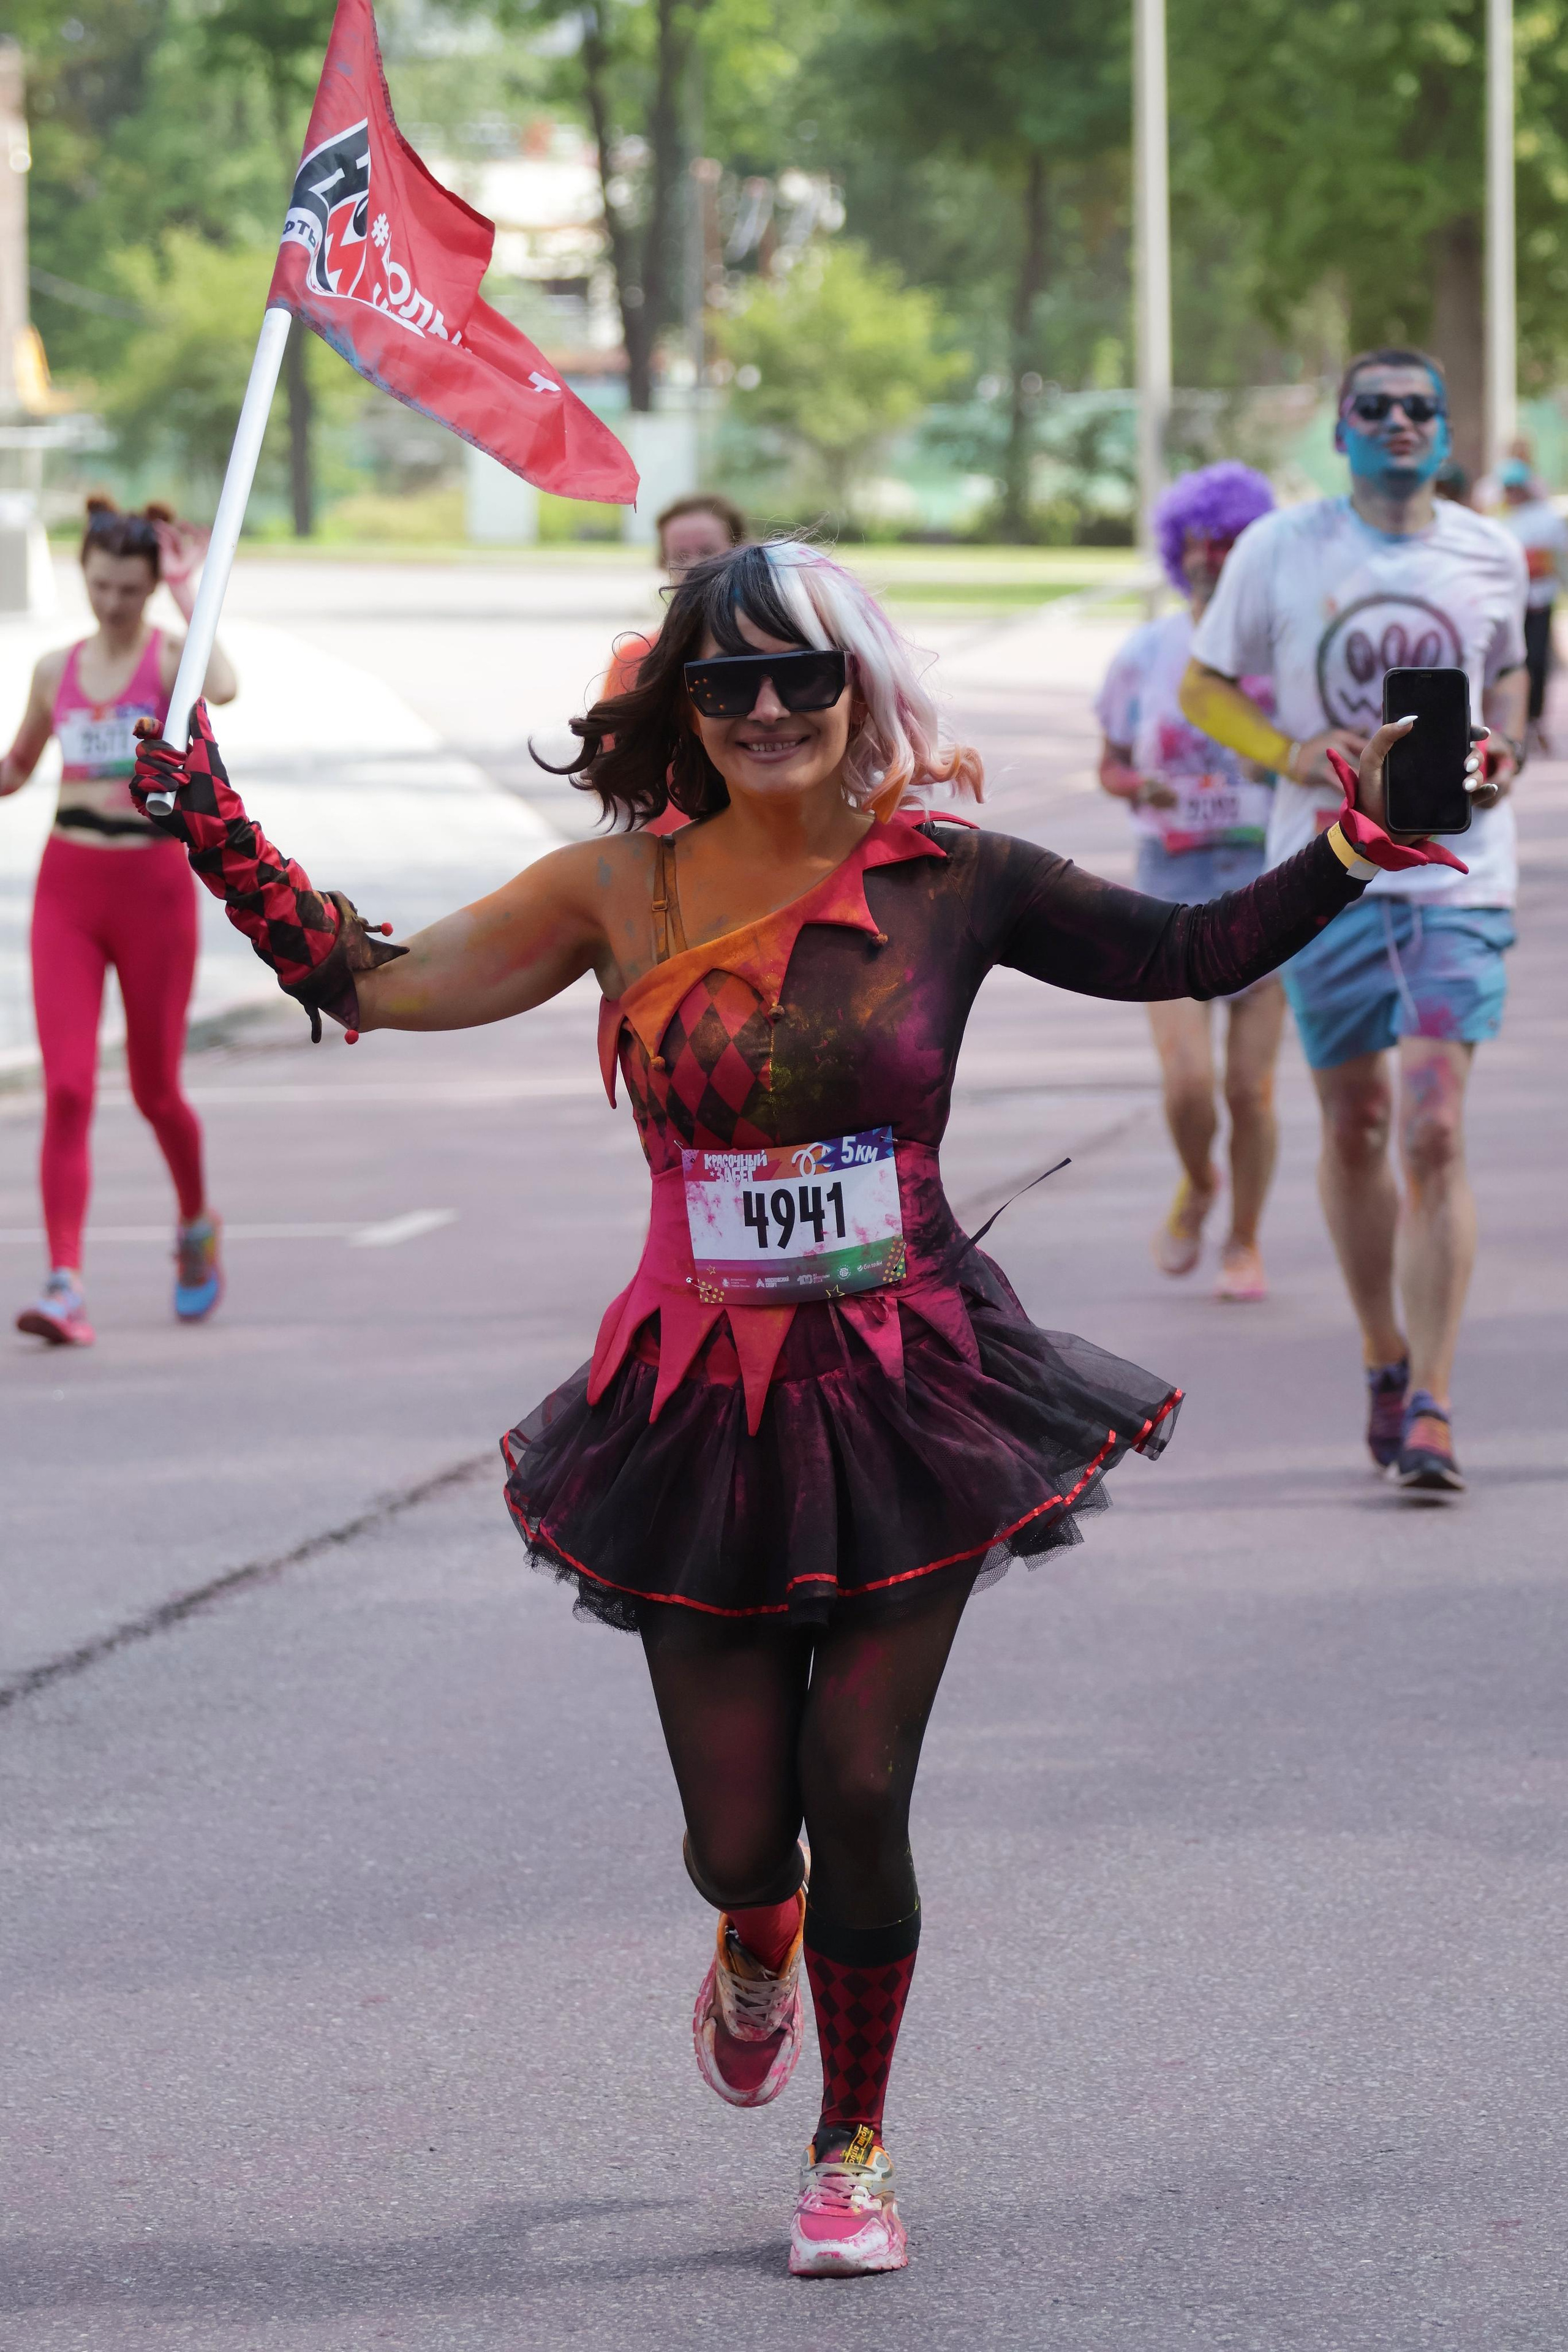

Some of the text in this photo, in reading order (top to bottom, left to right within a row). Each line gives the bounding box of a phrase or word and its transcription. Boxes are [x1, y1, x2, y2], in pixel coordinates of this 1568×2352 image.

[704, 1150, 767, 1170] КРАСОЧНЫЙ
[715, 1166, 756, 1183] ЗАБЕГ
[743, 1182, 846, 1250] 4941
